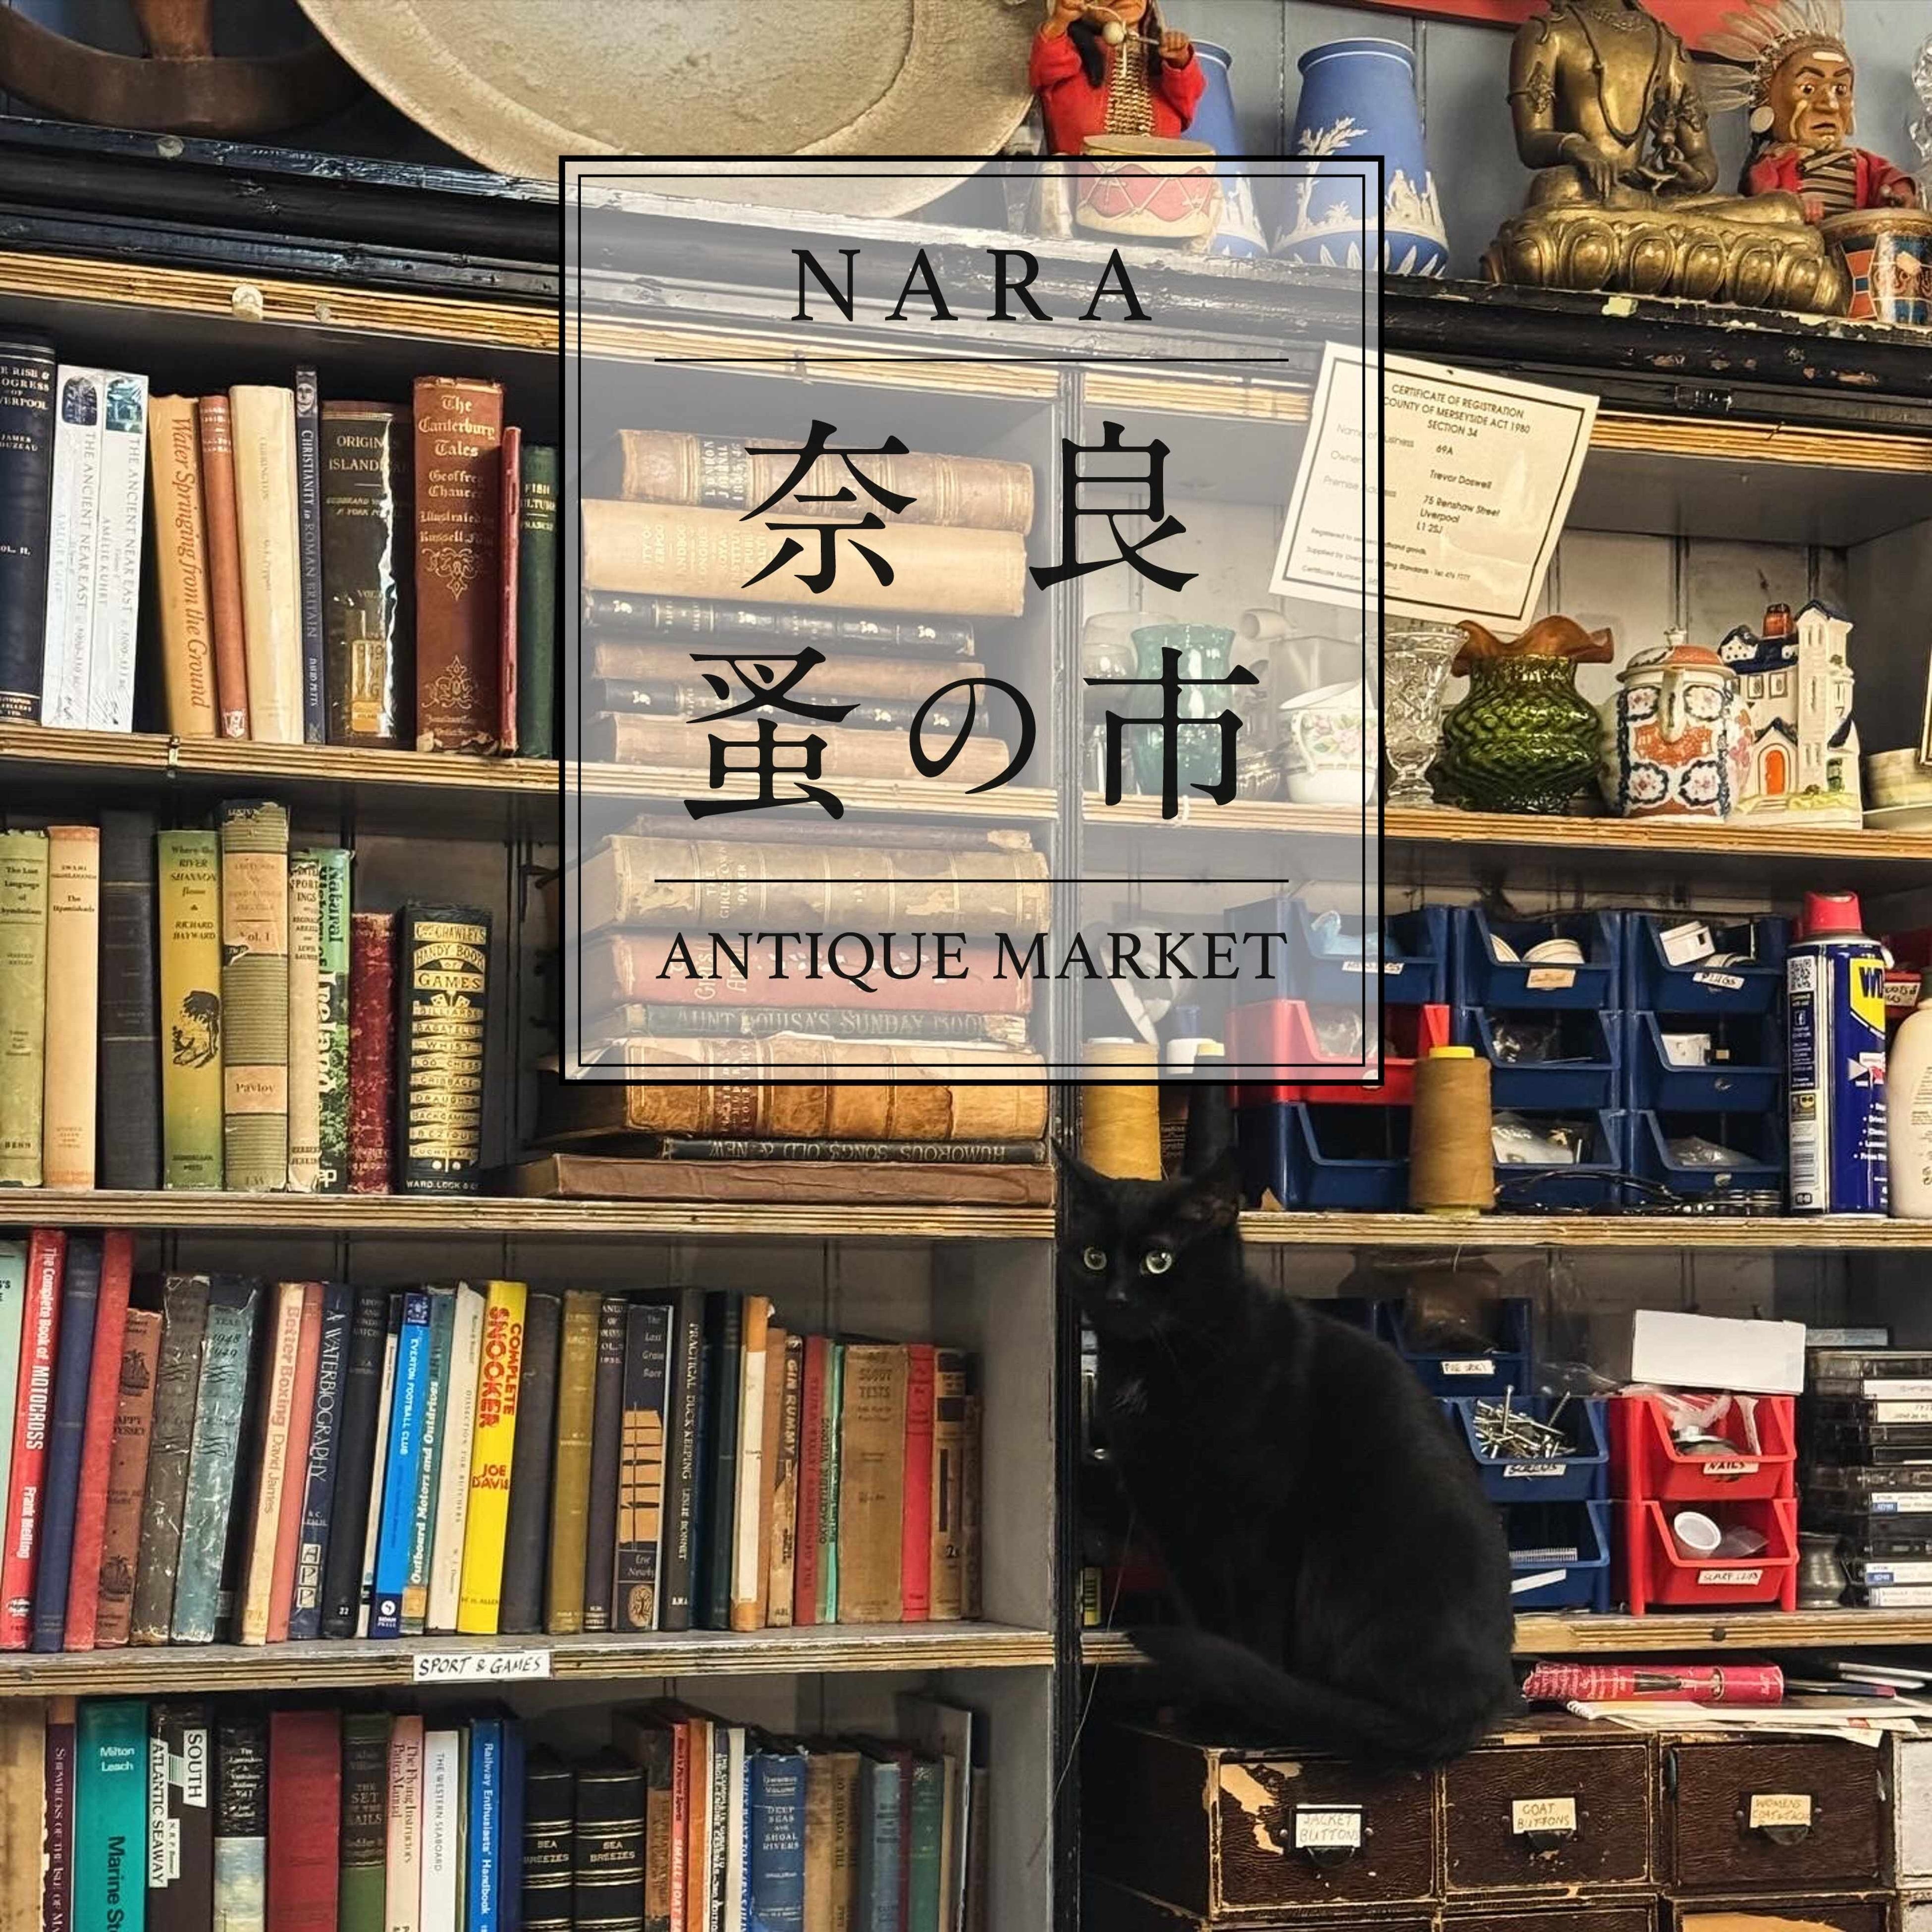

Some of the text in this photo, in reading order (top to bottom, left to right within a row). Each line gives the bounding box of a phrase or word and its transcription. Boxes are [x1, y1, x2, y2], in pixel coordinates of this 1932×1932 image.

[441, 394, 472, 414] The
[1392, 384, 1524, 419] CERTIFICATE OF REGISTRATION
[1384, 397, 1531, 434] COUNTY OF MERSEYSIDE ACT 1980
[419, 417, 495, 440] Canterbury
[1427, 420, 1478, 437] SECTION 34
[129, 438, 140, 463] THE
[434, 439, 479, 457] Tales
[1436, 445, 1453, 455] 69A
[302, 430, 314, 504] CHRISTIANITY
[126, 468, 139, 535] ANCIENT
[1423, 495, 1434, 505] 75
[77, 432, 96, 610] THE ANCIENT NEAR EAST
[1420, 508, 1460, 523] Liverpool
[122, 537, 136, 574] NEAR
[172, 419, 210, 707] Water Springing from the Ground
[305, 524, 316, 577] ROMAN
[121, 580, 133, 612] EAST
[306, 583, 318, 637] BRITAIN
[329, 866, 344, 942] Natural
[416, 944, 483, 970] HANDY BOOK
[418, 972, 482, 989] GAMES
[839, 1013, 924, 1034] SUNDAY
[427, 1040, 470, 1051] WHIST
[236, 1082, 275, 1093] Pavlov
[421, 1076, 472, 1087] CRIBBAGE
[417, 1094, 476, 1104] DRAUGHTS
[709, 1141, 748, 1158] NEW
[784, 1142, 820, 1157] OLD
[830, 1144, 889, 1158] SONGS
[900, 1145, 1005, 1159] HUMOROUS
[326, 1310, 345, 1321] A
[26, 1247, 57, 1450] The Complete Book of MOTOCROSS
[687, 1323, 699, 1389] PRACTICAL
[479, 1307, 510, 1428] SNOOKER
[503, 1323, 521, 1415] COMPLETE
[310, 1328, 342, 1481] WATERBIOGRAPHY
[399, 1339, 419, 1455] EVERTON FOOTBALL CLUB
[785, 1359, 798, 1454] GIN RUMMY
[265, 1306, 300, 1514] Better Boxing David James
[411, 1382, 439, 1584] Outboard Motors and Outdrives
[472, 1476, 509, 1490] DAVIS
[482, 1464, 506, 1477] JOE
[22, 1486, 37, 1516] Frank
[419, 1656, 540, 1677] SPORT & GAMES
[100, 1746, 135, 1757] Milton
[102, 1761, 133, 1772] Leach
[187, 1733, 203, 1798] SOUTH
[483, 1743, 494, 1786] Railway
[153, 1744, 164, 1882] ATLANTIC SEAWAY
[1517, 1815, 1569, 1829] BUTTONS
[1522, 1803, 1555, 1816] COAT
[537, 1840, 558, 1849] SEA
[1300, 1828, 1358, 1842] BUTTONS
[590, 1851, 635, 1862] BREEZES
[107, 1836, 125, 1905] Marine
[672, 1838, 683, 1913] SMALL BOAT
[481, 1859, 491, 1915] Handbook
